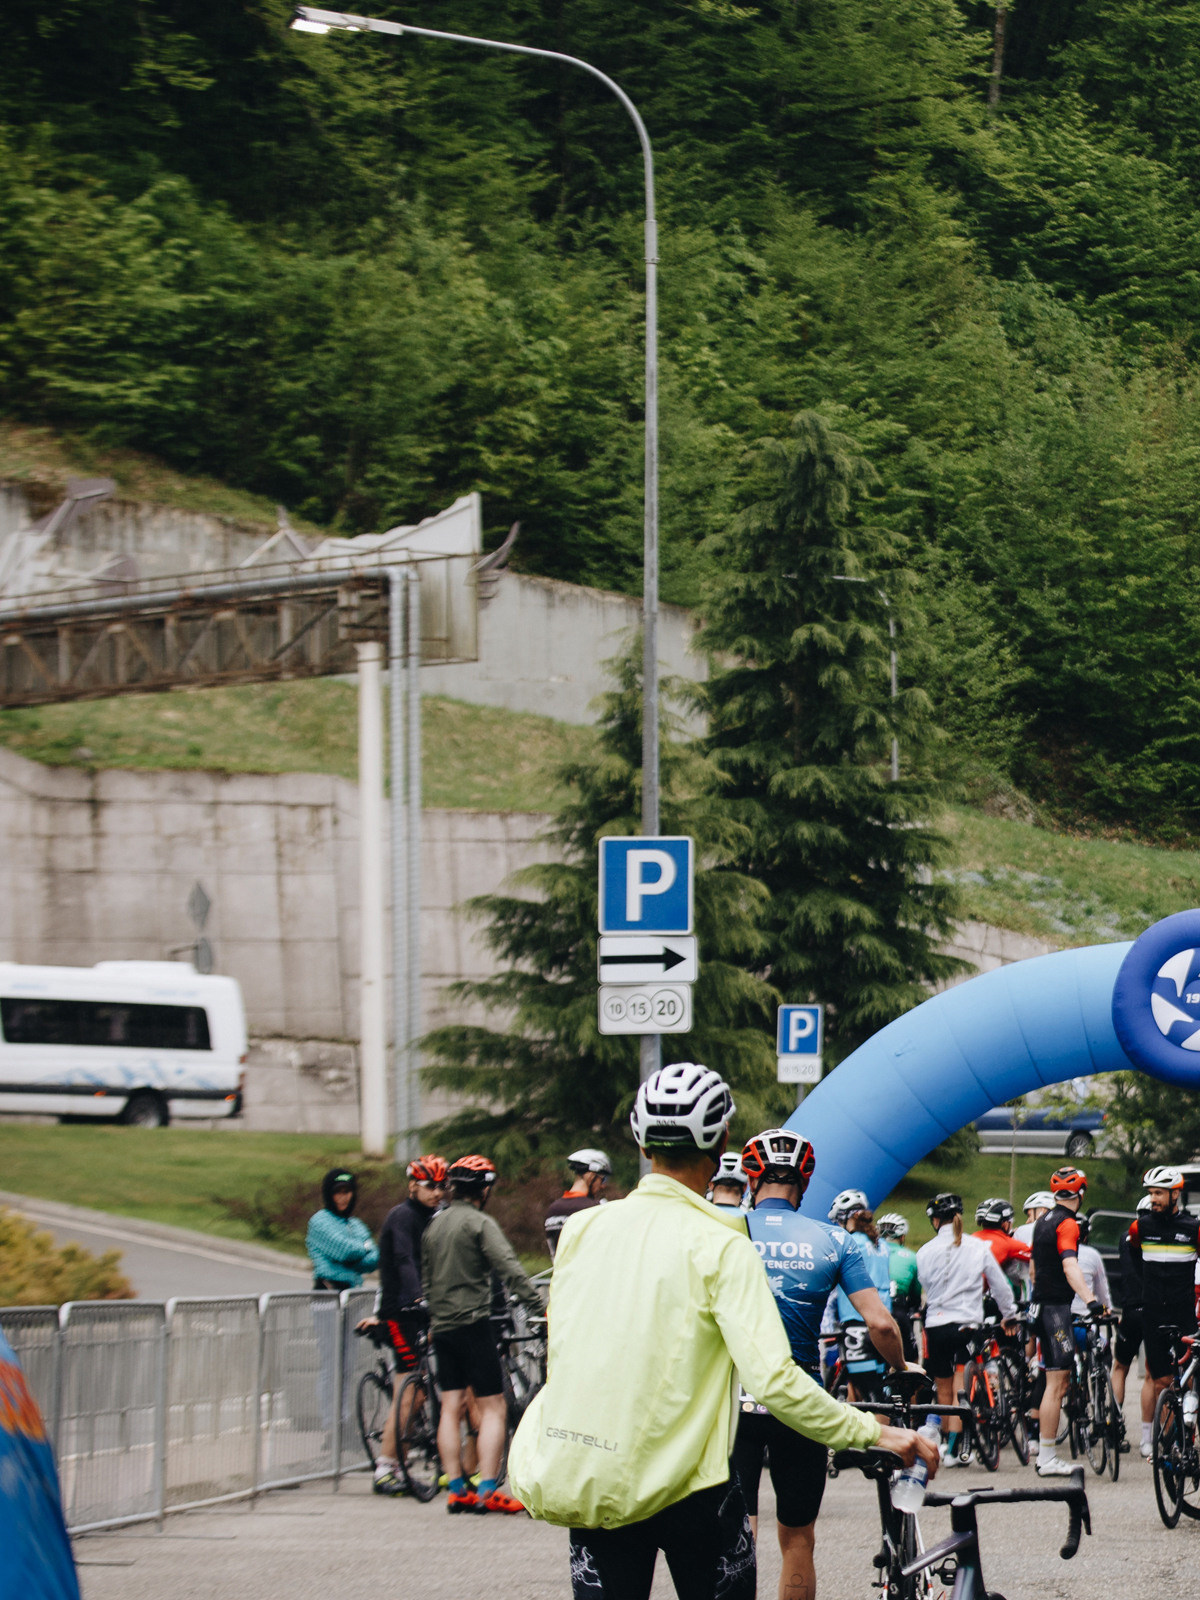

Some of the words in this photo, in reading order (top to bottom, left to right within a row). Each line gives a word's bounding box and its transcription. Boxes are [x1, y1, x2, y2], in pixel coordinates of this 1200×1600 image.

[626, 849, 677, 922] P
[609, 1003, 622, 1015] 10
[629, 1002, 646, 1016] 15
[656, 1000, 676, 1016] 20
[789, 1010, 815, 1051] P
[844, 1326, 868, 1361] RCA
